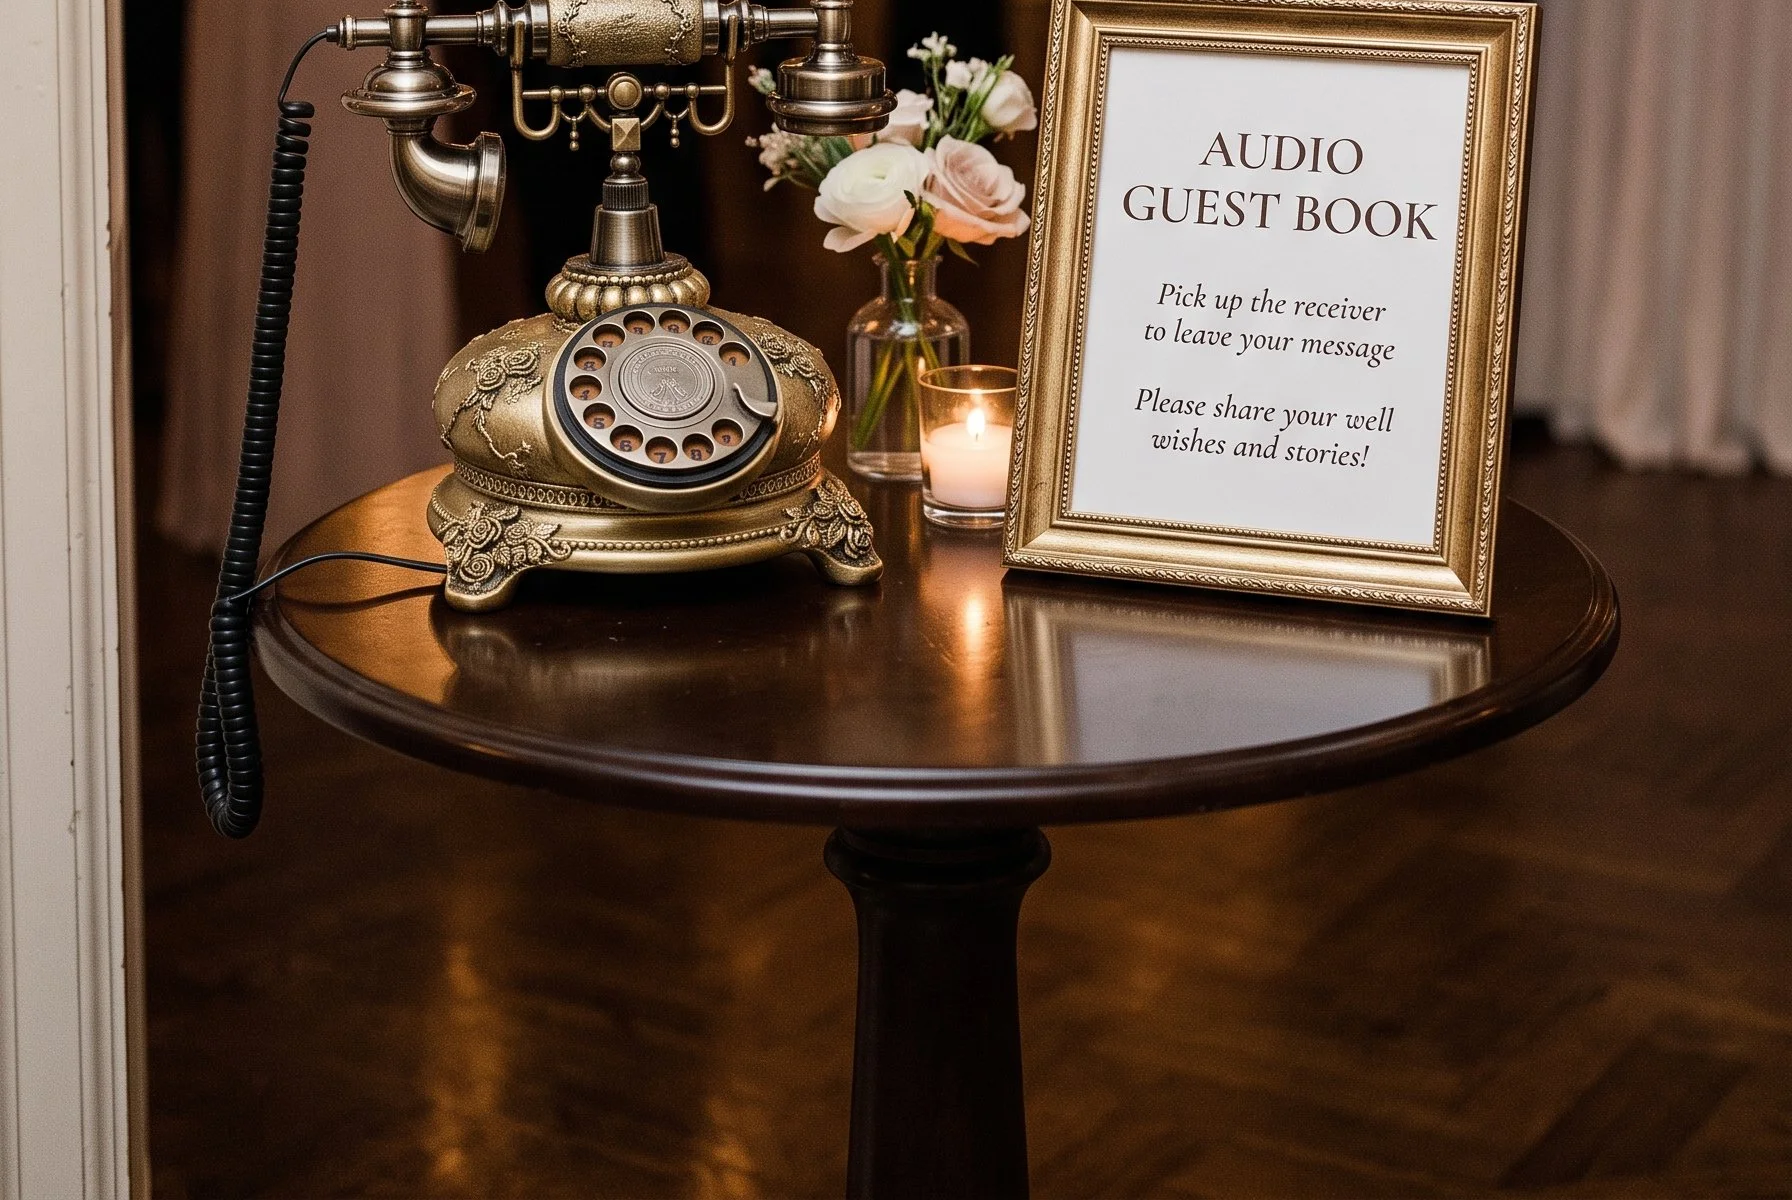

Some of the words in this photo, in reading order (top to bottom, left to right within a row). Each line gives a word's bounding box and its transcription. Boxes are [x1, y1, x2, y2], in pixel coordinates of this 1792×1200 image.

[1198, 131, 1364, 176] AUDIO
[1122, 184, 1281, 229] GUEST
[1292, 195, 1439, 241] BOOK
[1156, 282, 1207, 308] Pick
[1214, 294, 1243, 319] up
[1250, 287, 1287, 315] the
[1293, 297, 1387, 322] receiver
[1144, 323, 1167, 342] to
[1173, 317, 1233, 347] leave
[1235, 333, 1295, 357] your
[1301, 338, 1396, 369] message
[1134, 386, 1207, 417] Please
[1212, 393, 1276, 423] share
[1278, 408, 1338, 433] your
[1345, 406, 1395, 433] well
[620, 440, 632, 451] 6
[654, 452, 666, 463] 7
[1151, 426, 1227, 455] wishes
[1233, 434, 1280, 460] and
[1284, 442, 1370, 468] stories!
